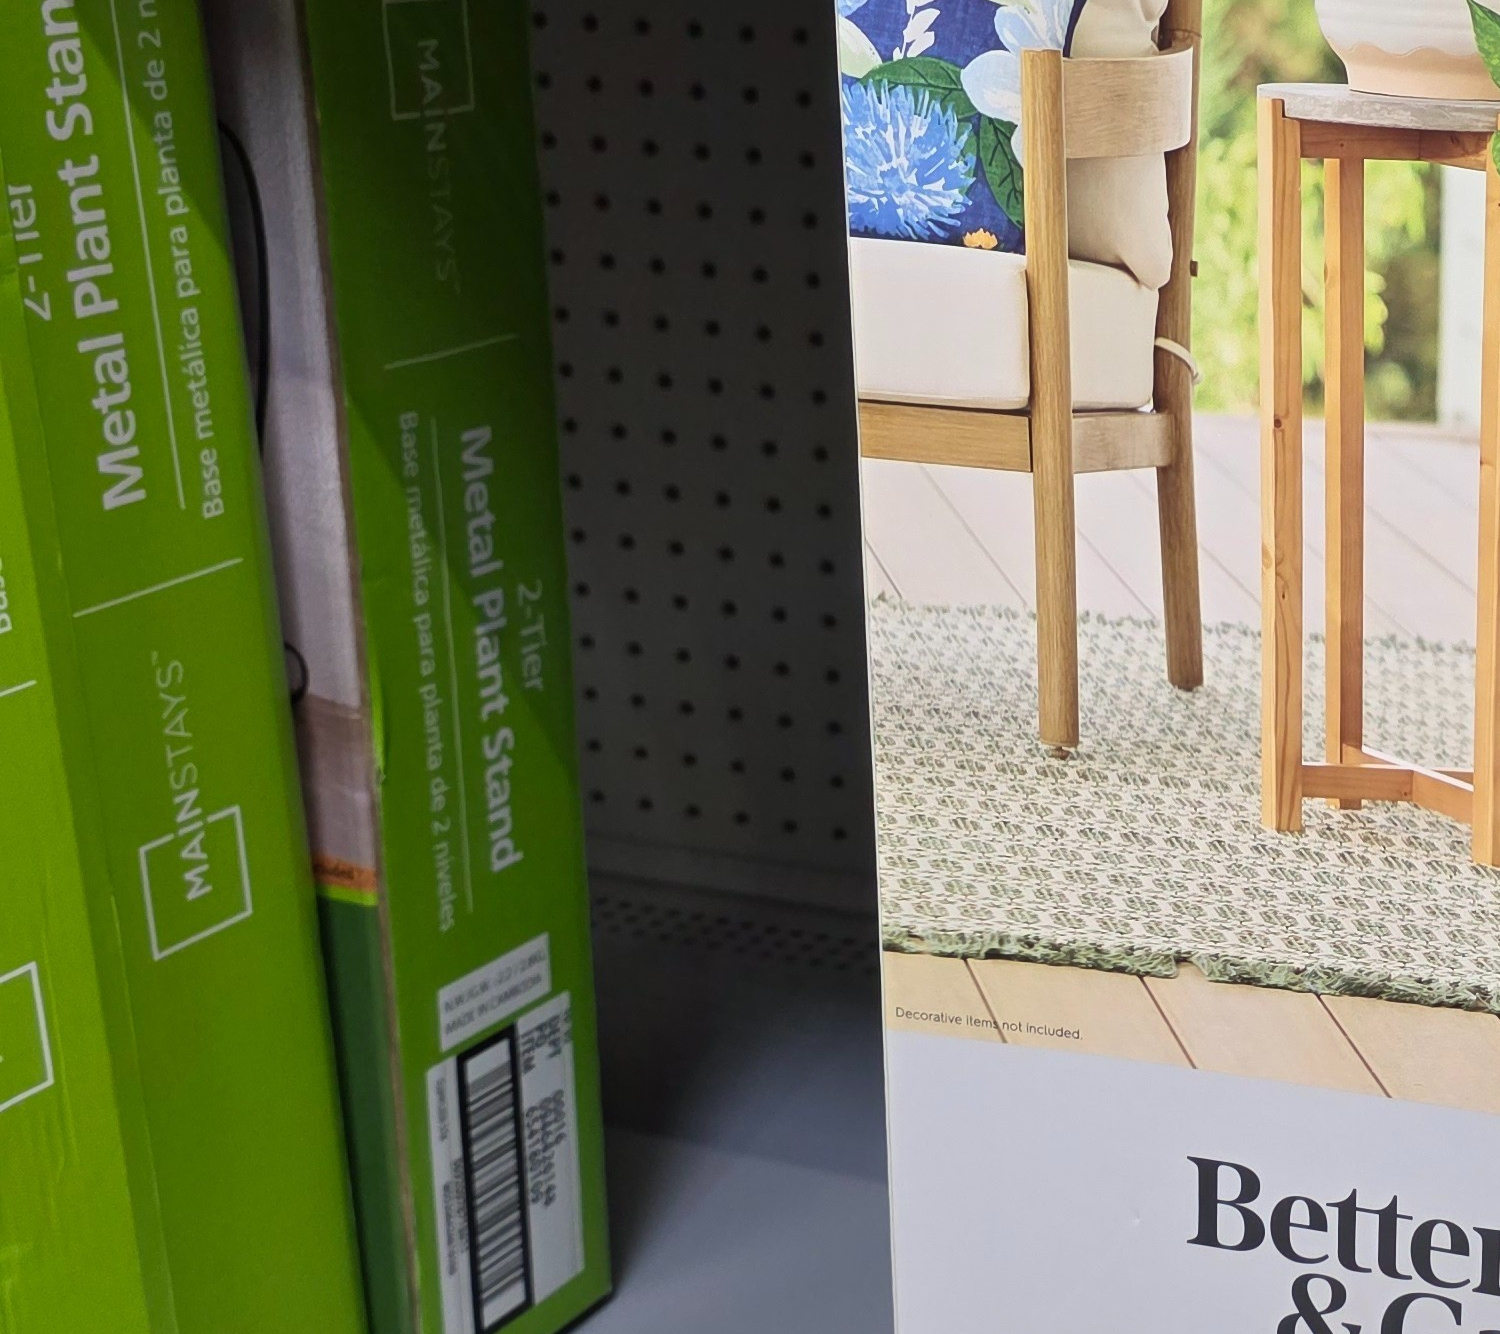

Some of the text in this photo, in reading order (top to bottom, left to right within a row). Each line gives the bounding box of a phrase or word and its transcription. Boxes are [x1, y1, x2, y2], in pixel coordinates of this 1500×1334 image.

[138, 28, 162, 49] 2
[143, 59, 168, 101] de
[153, 111, 189, 216] planta
[57, 154, 120, 319] Plant
[170, 225, 200, 298] para
[180, 307, 214, 439] metálica
[77, 332, 147, 510] Metal
[399, 411, 419, 478] Base
[202, 447, 225, 520] Base
[413, 613, 436, 677] para
[461, 425, 524, 873] Metal Plant Stand
[518, 579, 547, 691] 2-Tier
[419, 683, 444, 771] planta
[430, 776, 450, 811] de
[433, 842, 457, 933] niveles
[895, 1006, 1083, 1041] Decorative items not included.
